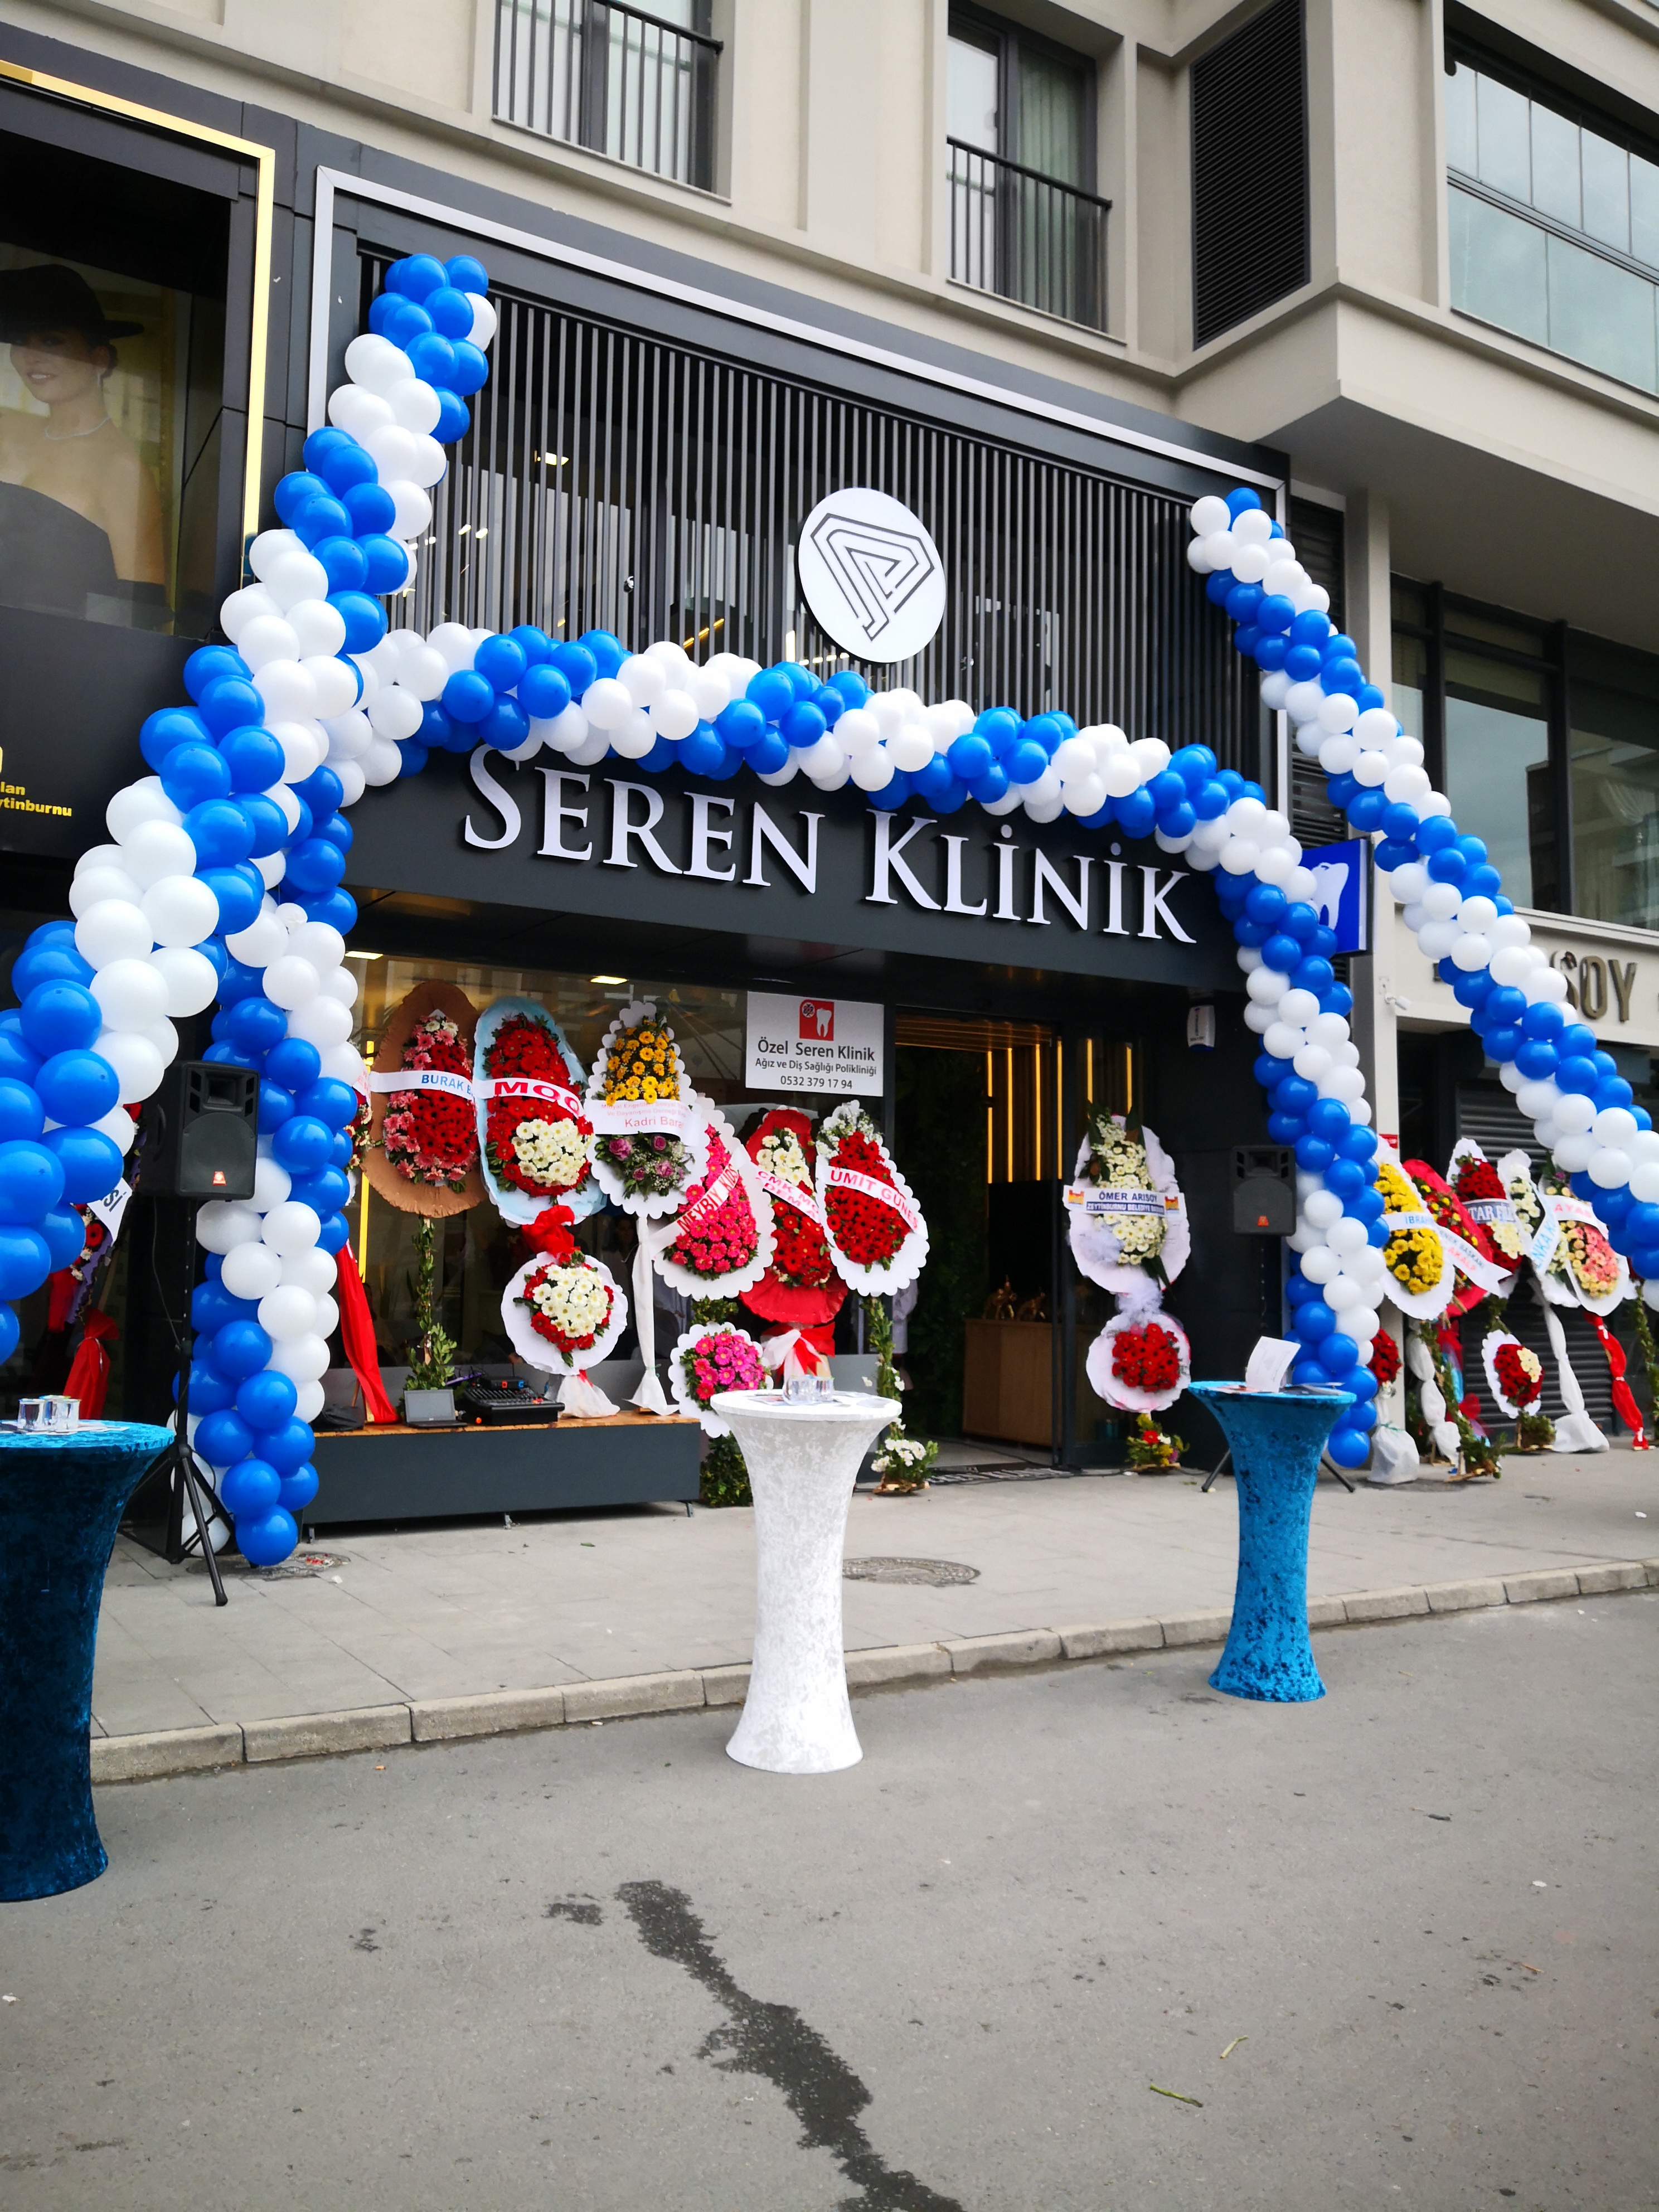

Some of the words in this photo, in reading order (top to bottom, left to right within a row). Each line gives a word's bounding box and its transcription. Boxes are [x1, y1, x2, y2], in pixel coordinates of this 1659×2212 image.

[465, 744, 825, 894] SEREN
[866, 809, 1197, 943] KLİNİK
[758, 1037, 788, 1054] Özel
[795, 1042, 833, 1058] Seren
[838, 1045, 875, 1061] Klinik
[755, 1058, 774, 1069] Ağız
[789, 1060, 803, 1071] Diş
[805, 1061, 833, 1074] Sağlığı
[836, 1064, 876, 1076] Polikliniği
[421, 1074, 464, 1090] BURAK
[780, 1075, 804, 1086] 0532
[807, 1078, 824, 1087] 379
[828, 1079, 838, 1088] 17
[841, 1080, 852, 1089] 94
[625, 1117, 656, 1128] Kadri
[661, 1116, 684, 1128] Bara
[1099, 1190, 1127, 1200] ÖMER
